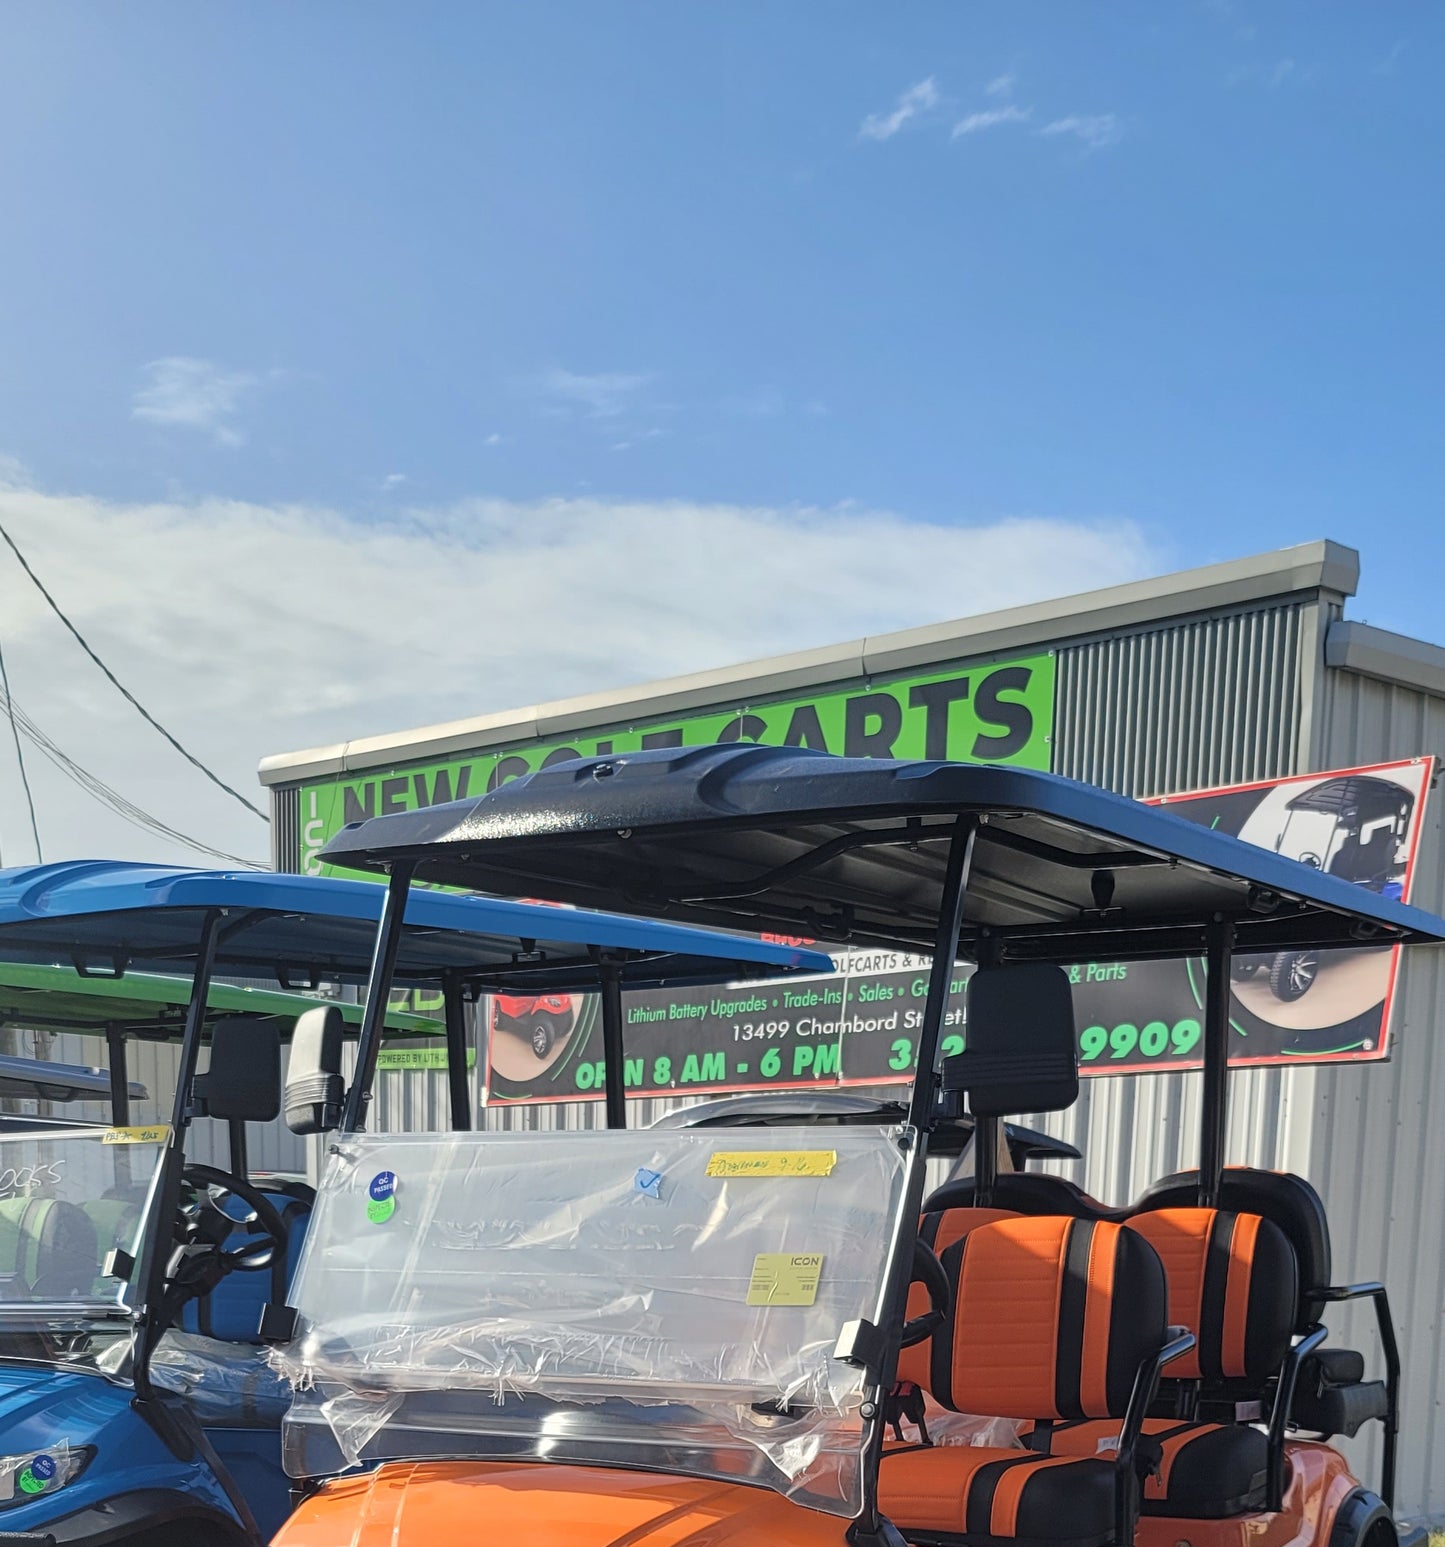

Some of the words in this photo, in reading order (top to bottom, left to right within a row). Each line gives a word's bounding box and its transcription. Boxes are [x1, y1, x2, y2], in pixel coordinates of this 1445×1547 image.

[627, 1005, 666, 1024] Lithium
[669, 1004, 708, 1021] Battery
[711, 995, 767, 1018] Upgrades
[783, 988, 842, 1009] Trade-Ins
[859, 983, 893, 1003] Sales
[1086, 961, 1127, 982] Parts
[733, 1021, 790, 1041] 13499
[796, 1011, 898, 1036] Chambord
[575, 1059, 644, 1090] OPN
[653, 1056, 672, 1085] 8
[680, 1052, 726, 1083] AM
[760, 1048, 781, 1078] 6
[792, 1043, 842, 1076] PM
[790, 1256, 820, 1267] ICON
